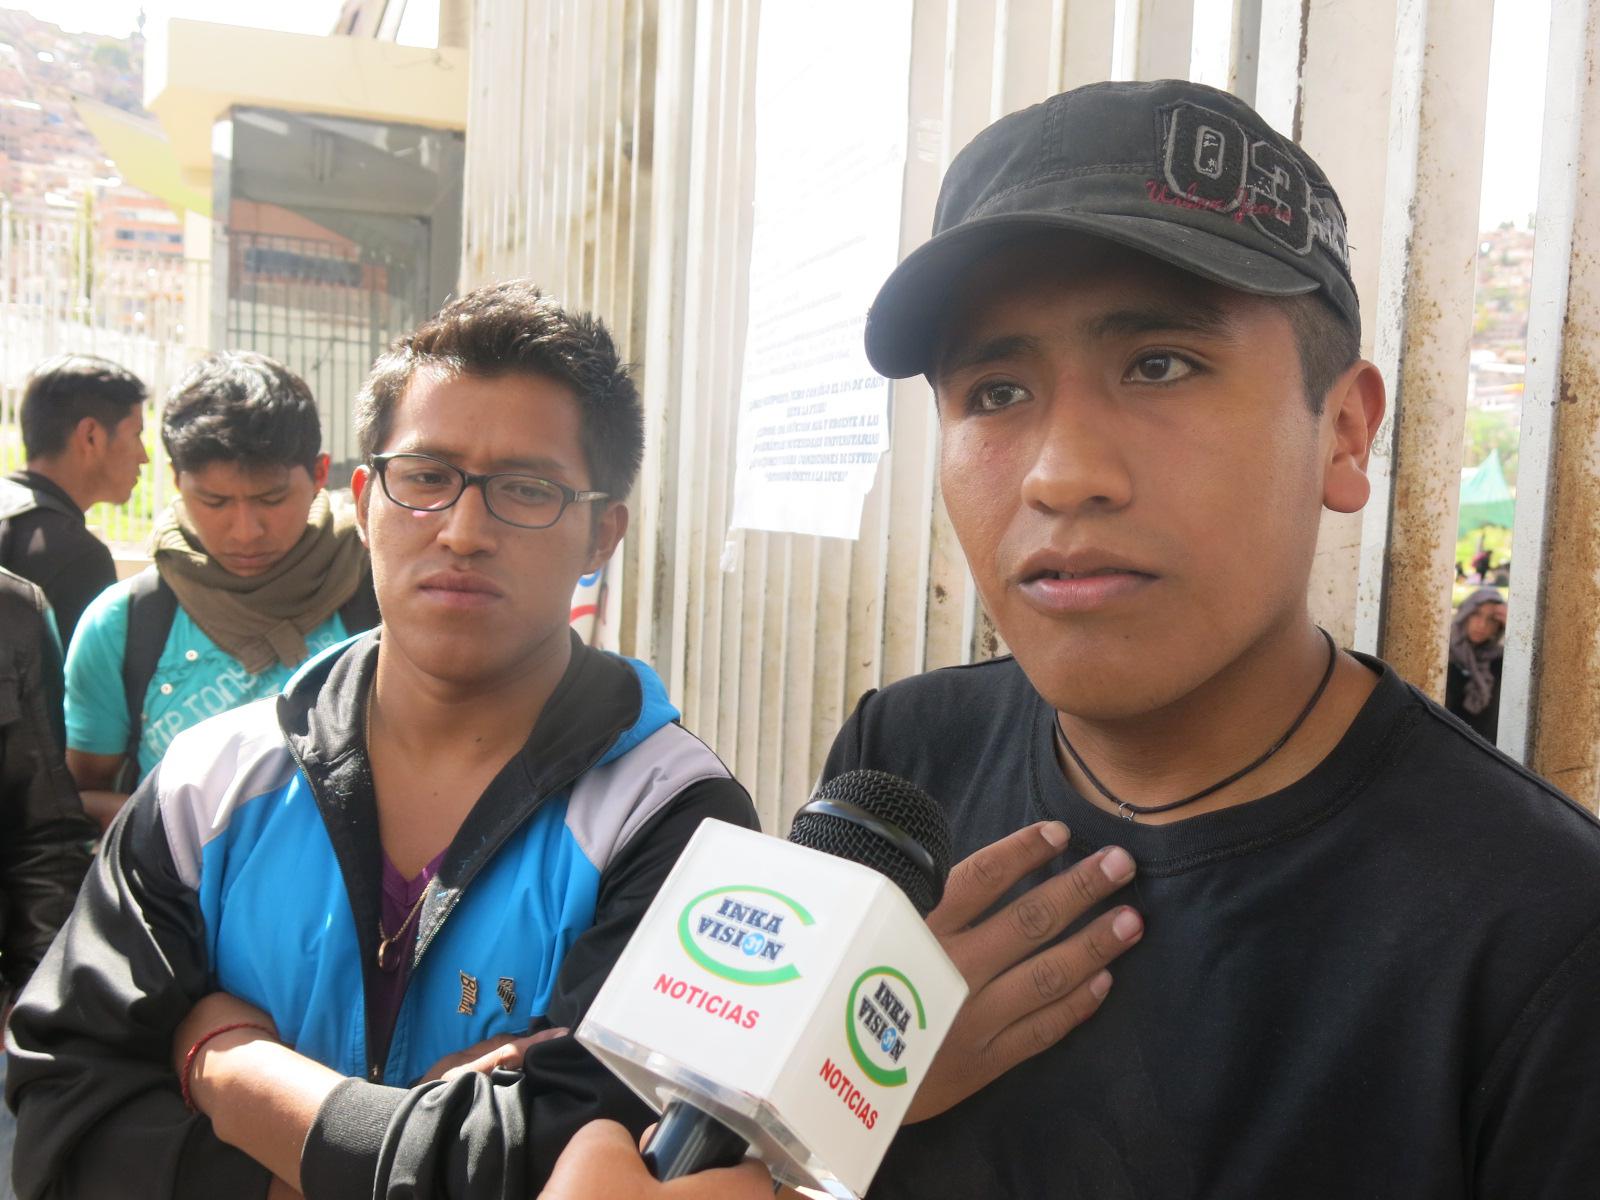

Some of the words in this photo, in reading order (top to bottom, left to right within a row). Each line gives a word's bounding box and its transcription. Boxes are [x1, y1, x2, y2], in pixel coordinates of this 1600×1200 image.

[717, 899, 784, 934] INKA
[653, 973, 760, 1029] NOTICIAS
[874, 980, 911, 1034] INKA
[819, 1058, 878, 1131] NOTICIAS
